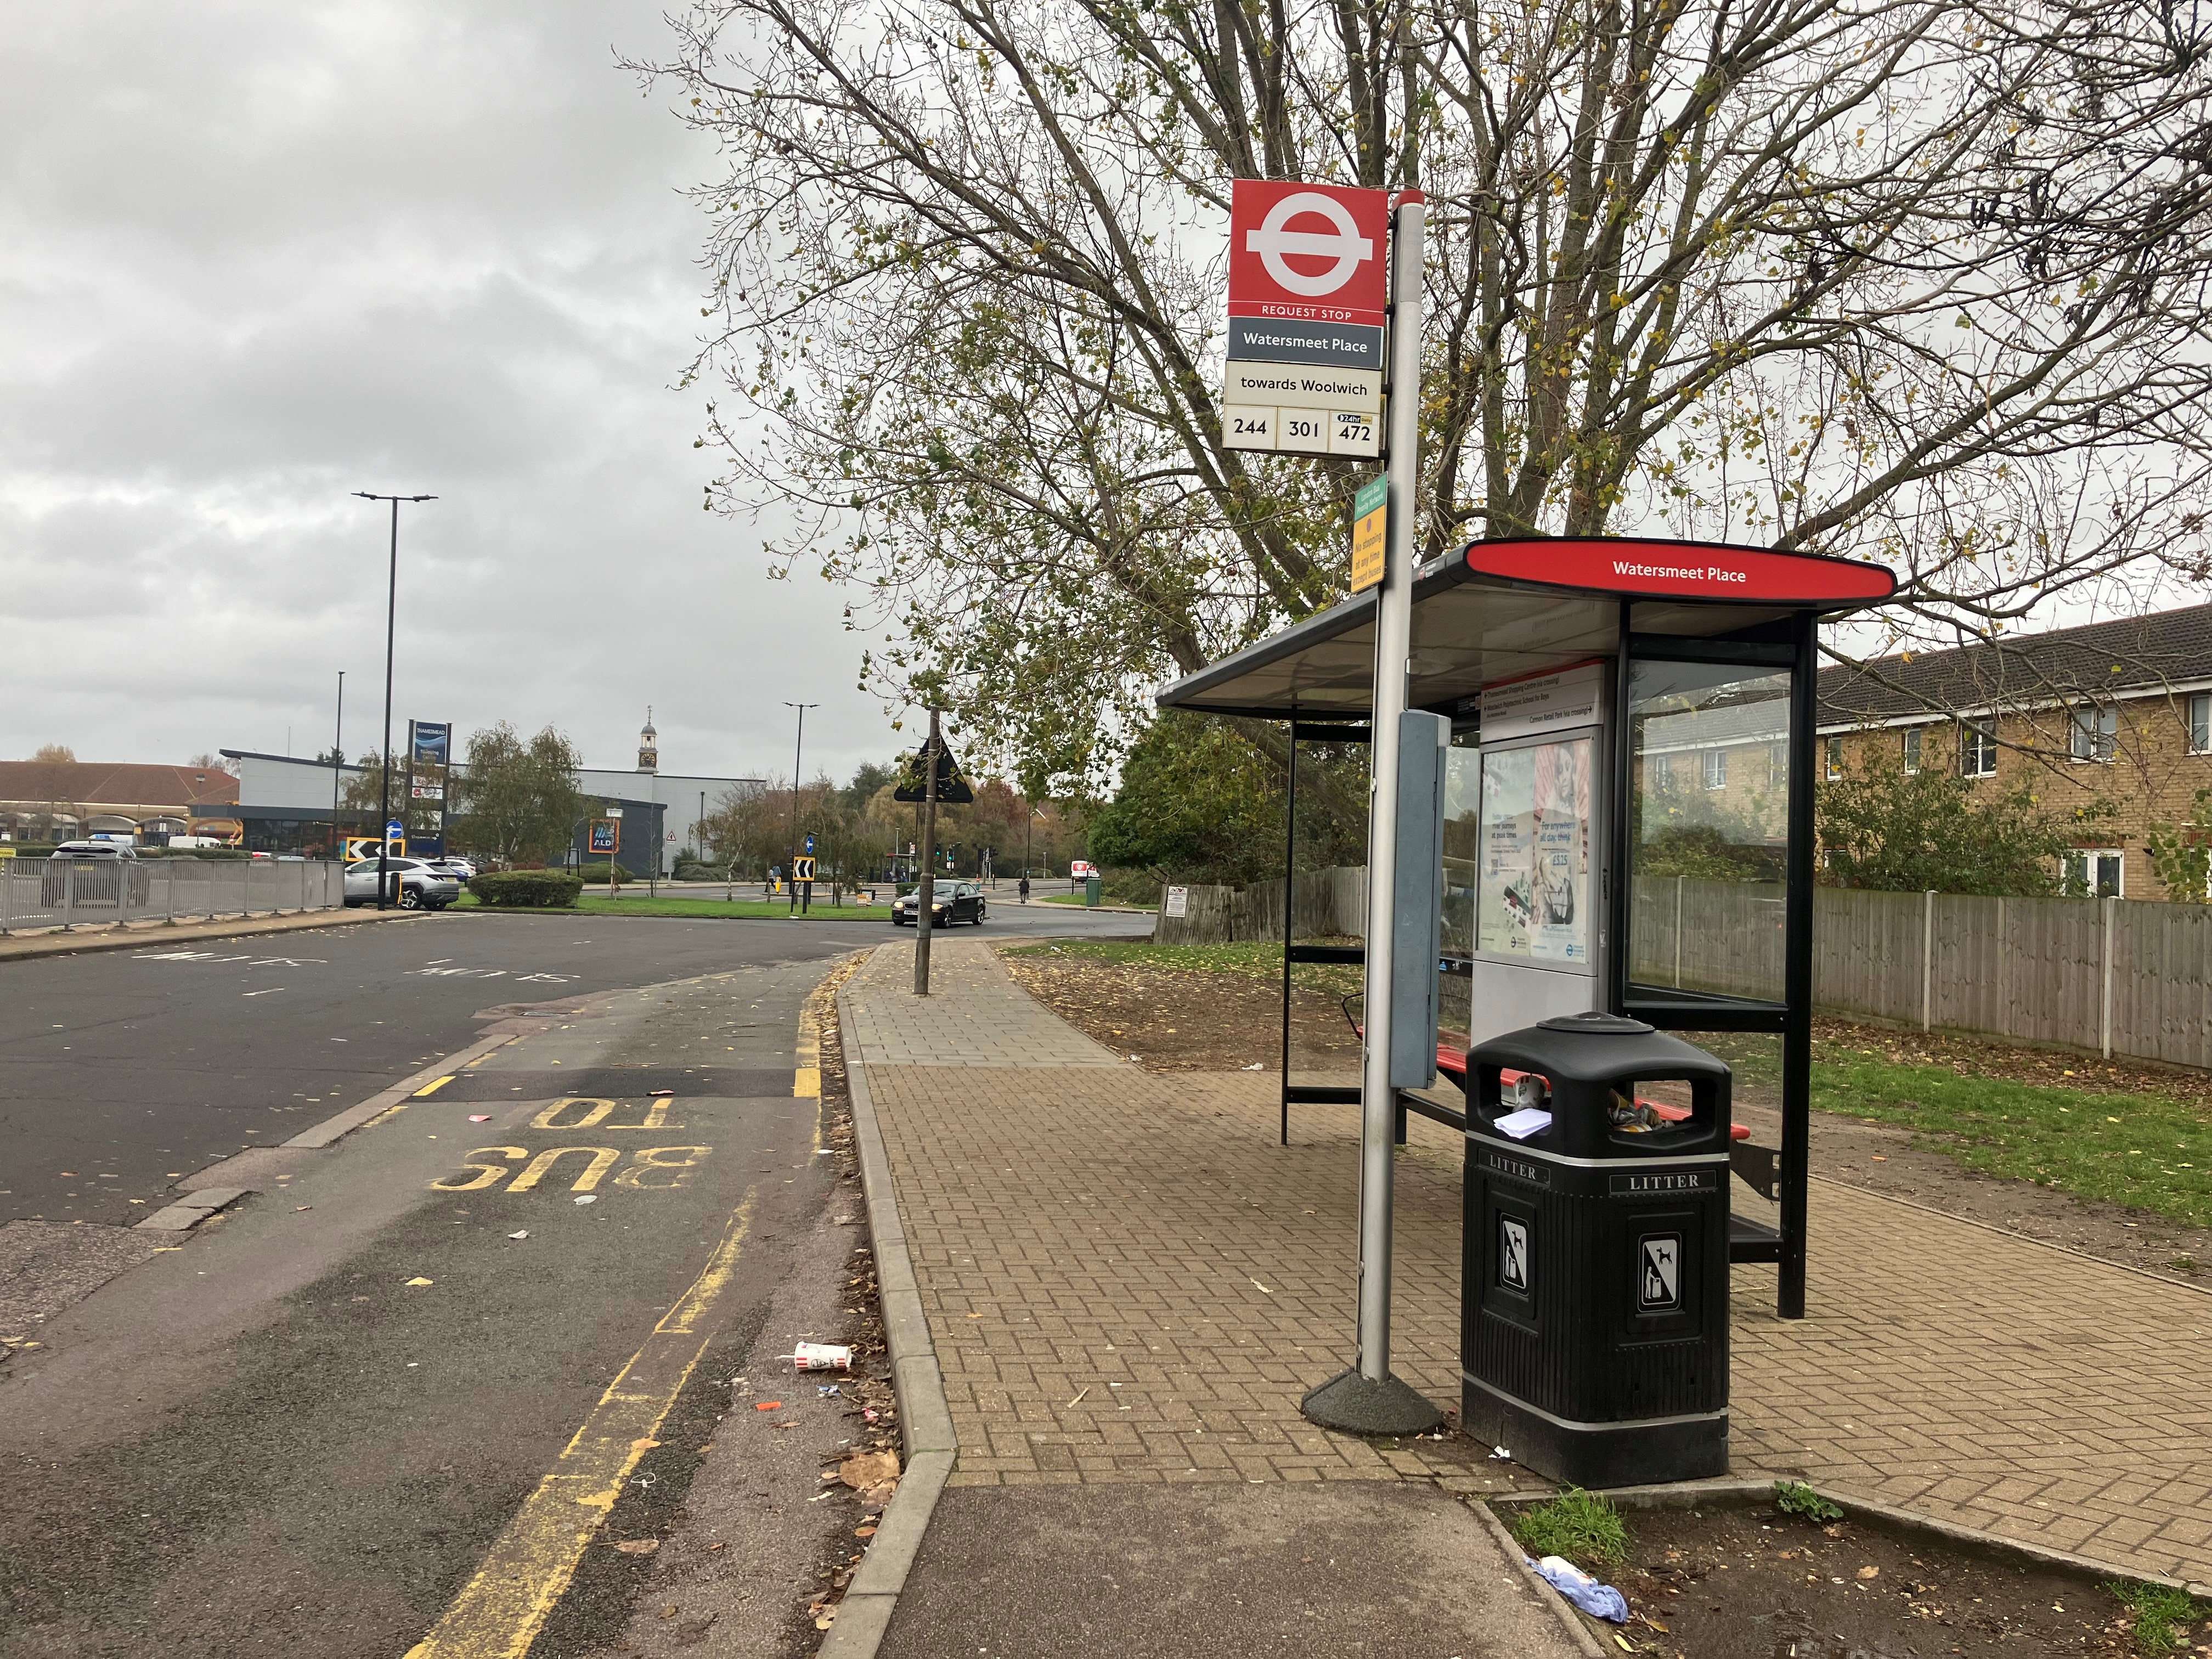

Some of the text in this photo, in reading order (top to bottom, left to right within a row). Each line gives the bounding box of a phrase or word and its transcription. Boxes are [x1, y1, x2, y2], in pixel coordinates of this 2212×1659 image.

[1262, 305, 1352, 320] REQUEST STOP
[1243, 332, 1368, 353] Watersmeet Place
[1241, 376, 1368, 396] towards Woolwich
[1234, 418, 1267, 435] 244
[1289, 421, 1318, 437] 301
[1339, 425, 1370, 441] 472
[1356, 533, 1381, 554] No stopping
[1356, 559, 1360, 570] at
[1370, 550, 1380, 563] time
[1353, 565, 1381, 586] except buses
[1613, 561, 1746, 583] Watersmeet Place
[425, 1146, 713, 1192] BUS
[1489, 1154, 1536, 1180] LITTER
[1630, 1174, 1699, 1190] LITTER
